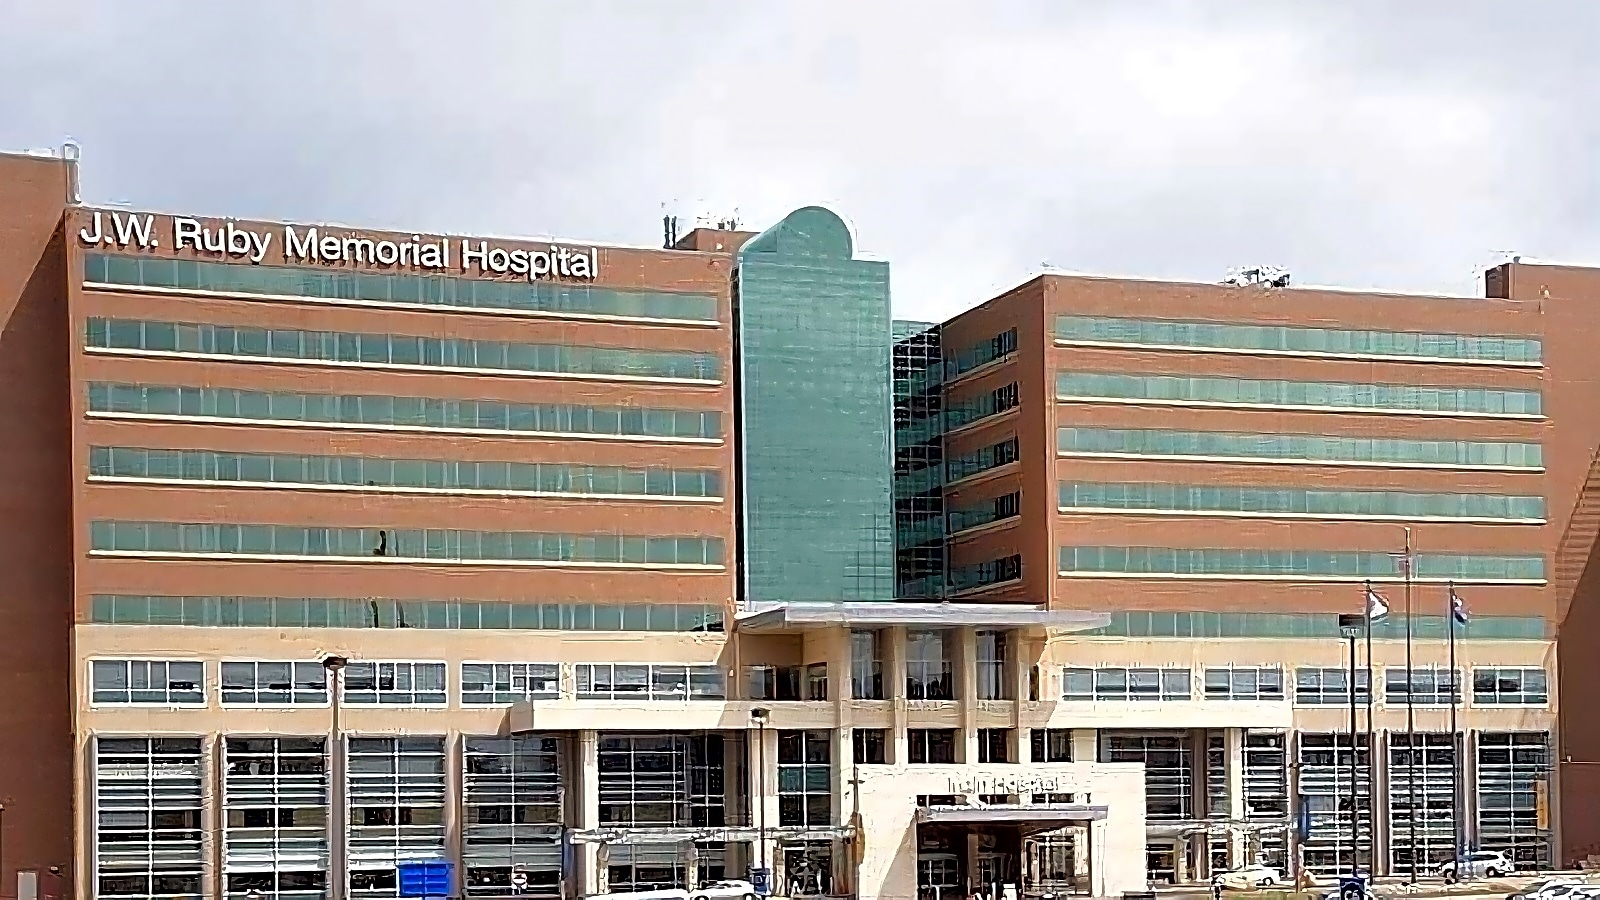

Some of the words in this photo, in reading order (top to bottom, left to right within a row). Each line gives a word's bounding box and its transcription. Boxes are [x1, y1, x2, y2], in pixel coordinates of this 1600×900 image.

[80, 211, 158, 248] J.W.
[174, 217, 272, 263] Ruby
[284, 225, 450, 269] Memorial
[462, 239, 599, 280] Hospital
